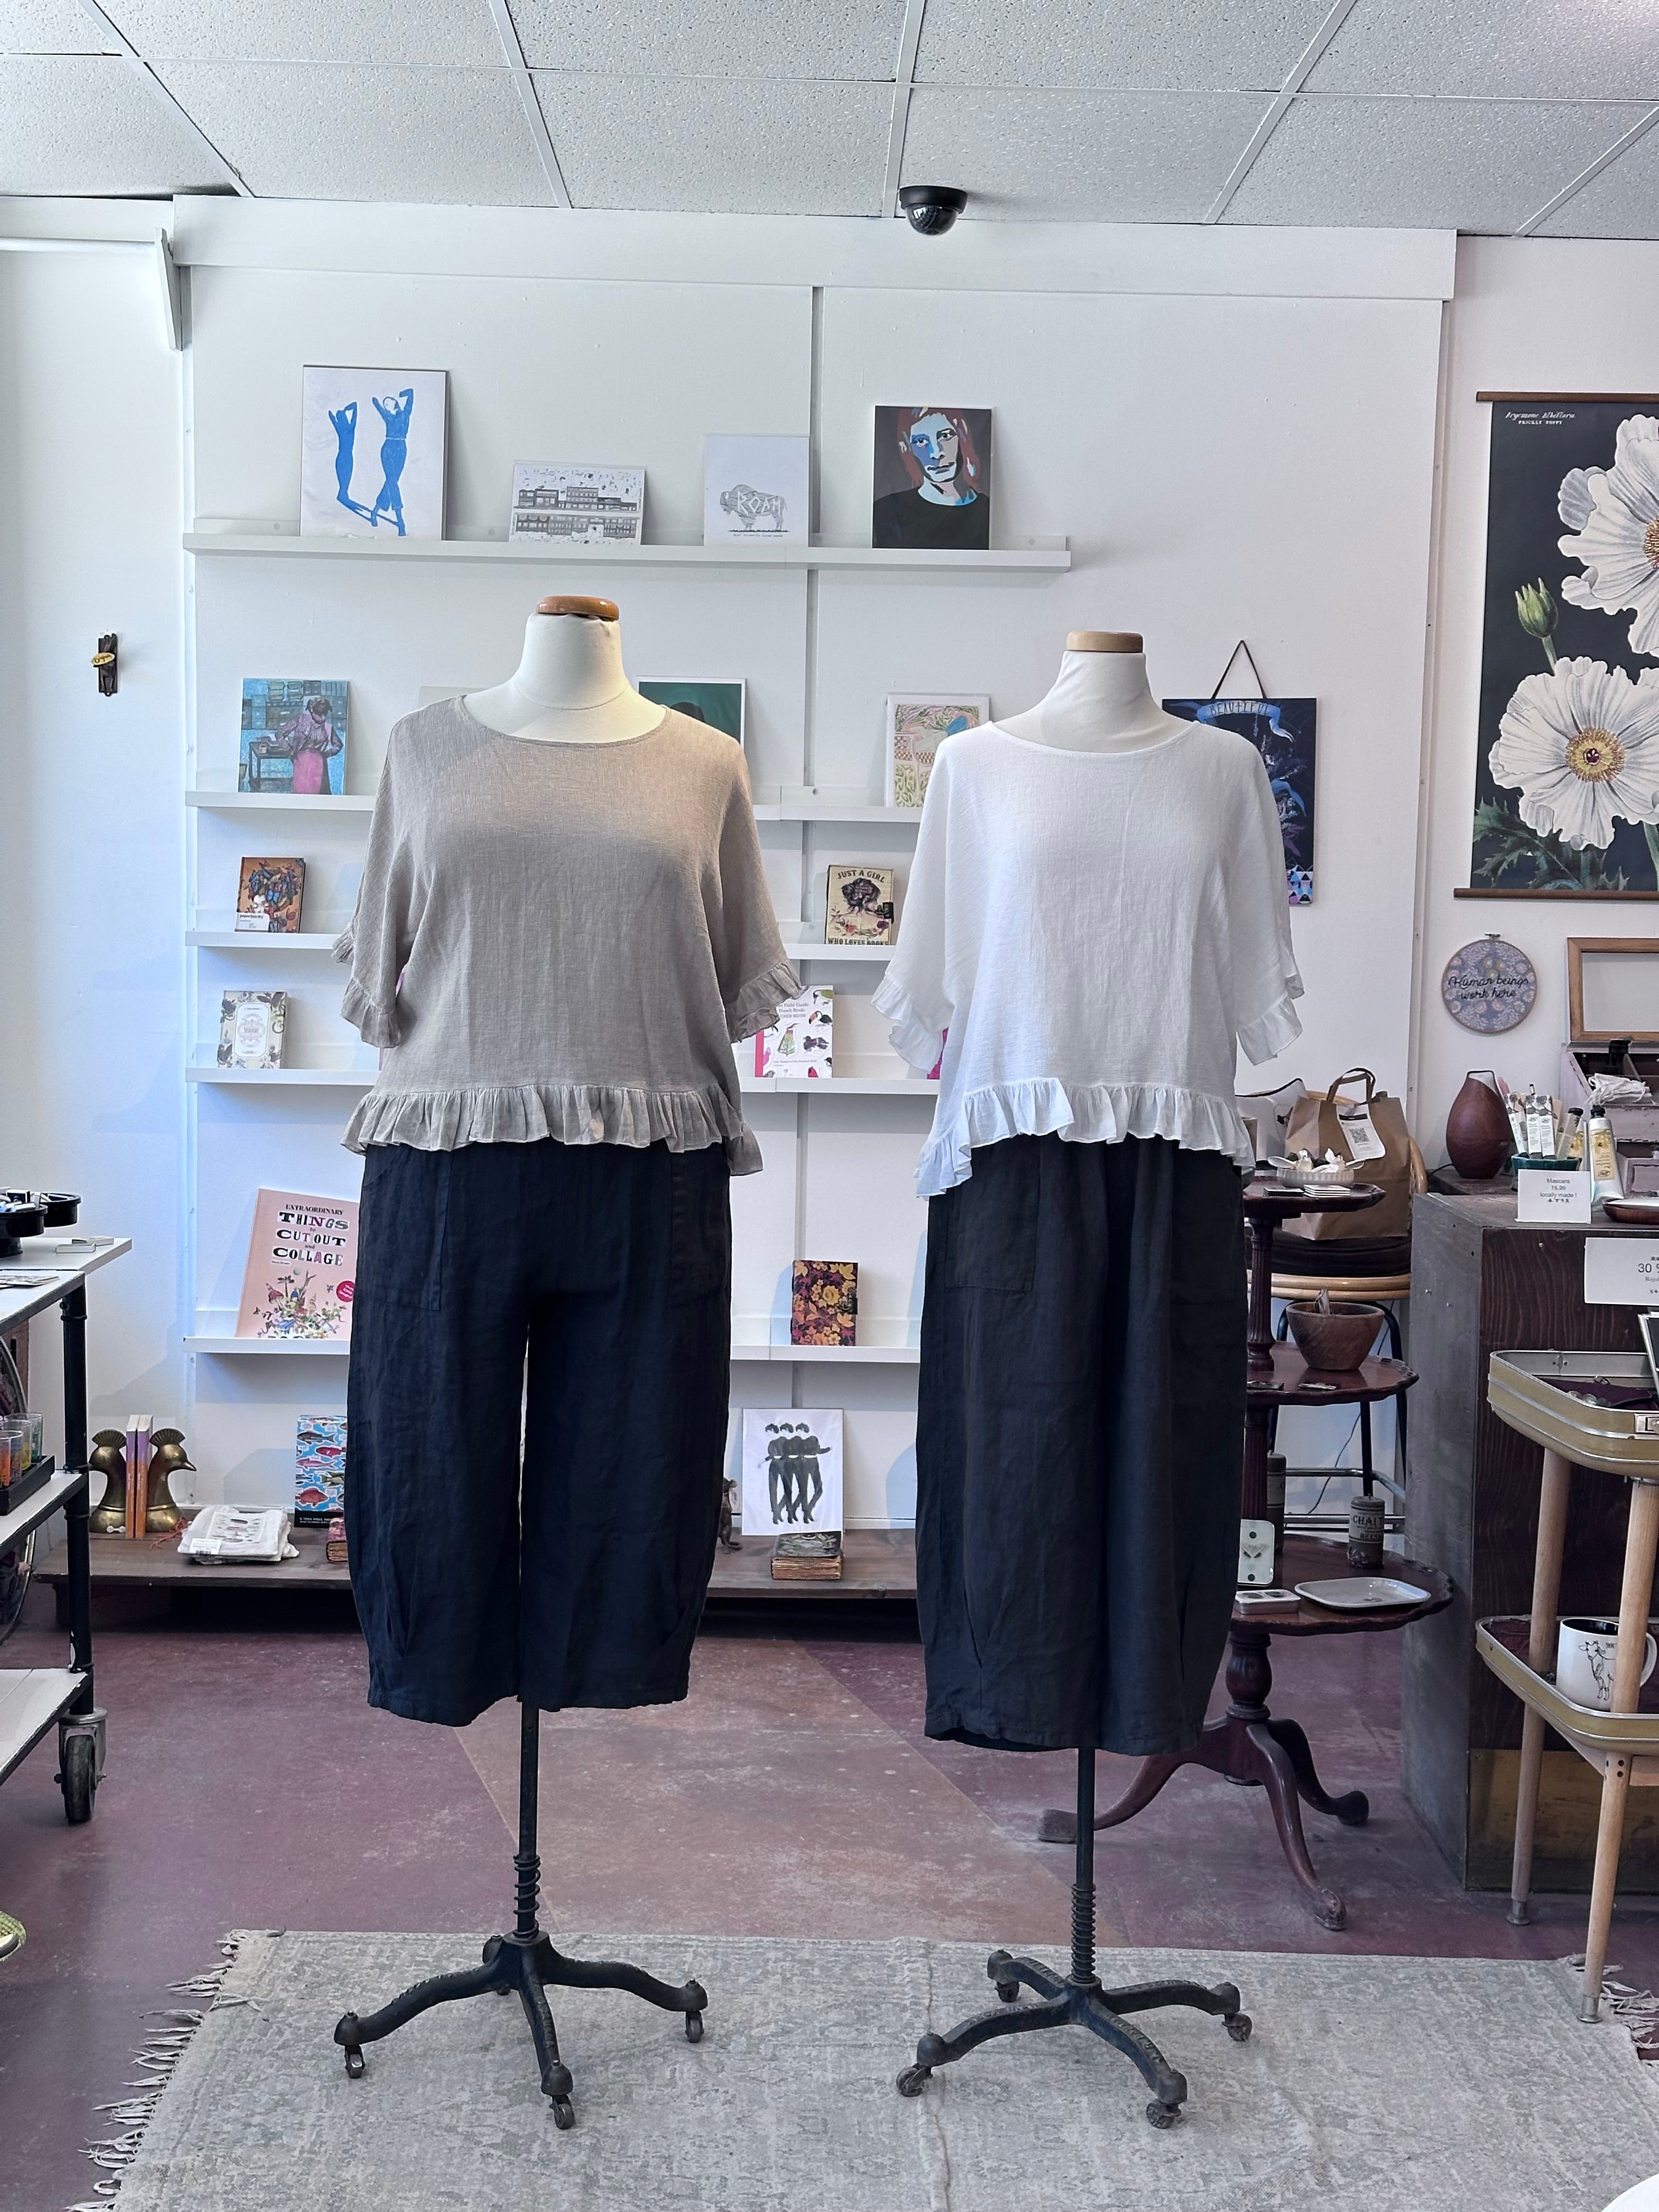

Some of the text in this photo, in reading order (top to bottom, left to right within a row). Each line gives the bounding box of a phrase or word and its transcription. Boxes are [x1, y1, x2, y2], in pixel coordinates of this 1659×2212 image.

[737, 490, 781, 517] ROAM
[1210, 702, 1269, 716] BEAUTIFUL
[837, 870, 856, 879] JUST
[867, 871, 885, 883] GIRL
[1448, 974, 1528, 989] Human beings
[1461, 988, 1516, 999] work here
[285, 1204, 343, 1216] EXTRAORDINARY
[279, 1211, 349, 1230] THINGS
[276, 1229, 346, 1247] CUT OUT
[273, 1247, 343, 1266] COLLAGE
[1638, 1263, 1652, 1273] 30
[1353, 1515, 1376, 1525] CHAI
